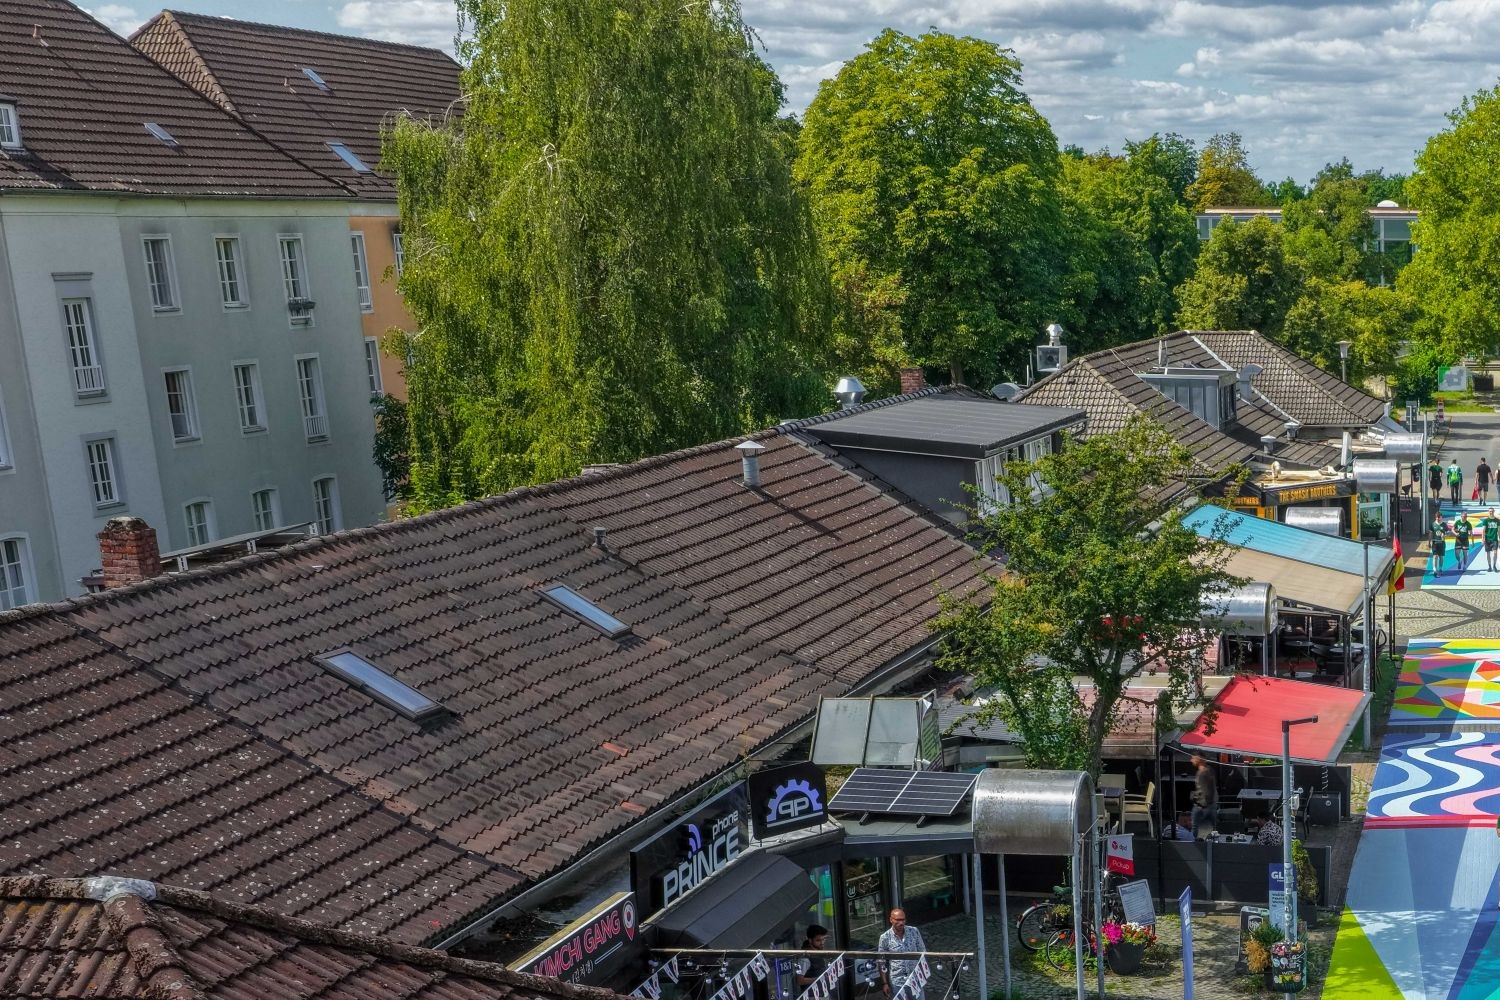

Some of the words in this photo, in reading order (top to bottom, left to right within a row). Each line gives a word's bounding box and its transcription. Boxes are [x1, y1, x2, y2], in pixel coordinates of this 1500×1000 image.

[712, 810, 738, 839] phone
[664, 826, 740, 908] PRINCE
[584, 910, 620, 953] GANG
[780, 961, 792, 972] 1&1
